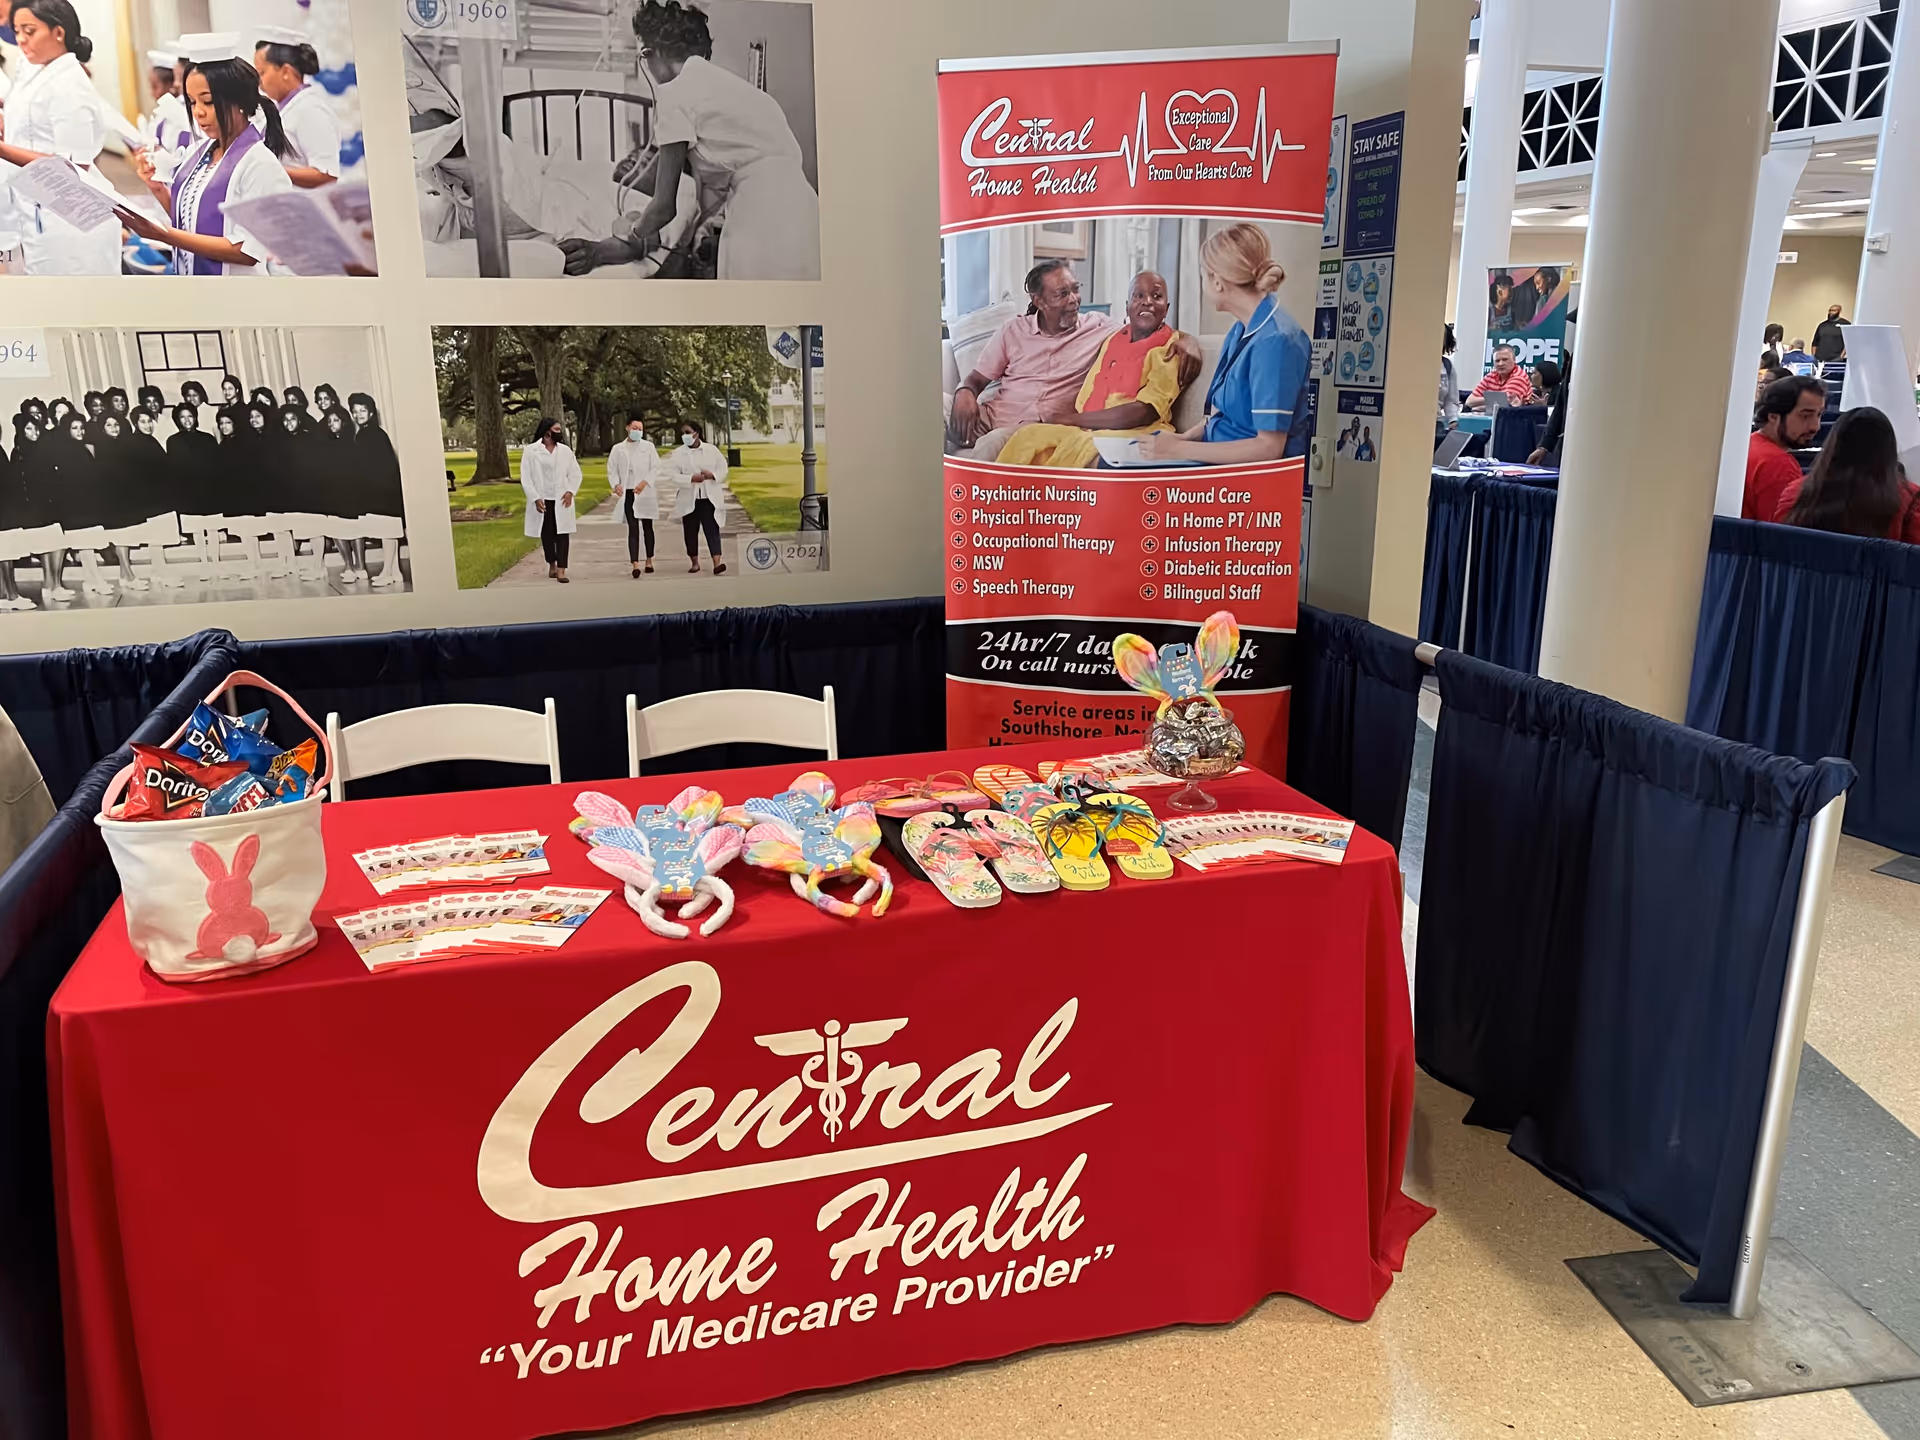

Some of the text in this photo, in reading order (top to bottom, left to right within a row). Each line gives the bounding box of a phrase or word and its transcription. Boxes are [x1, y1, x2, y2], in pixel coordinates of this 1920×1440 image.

[459, 0, 507, 23] 1960
[1171, 107, 1231, 126] Exceptional
[961, 97, 1098, 168] Central
[1188, 133, 1212, 152] Care
[1353, 131, 1399, 155] STAY SAFE
[967, 164, 1098, 198] Home Health
[1148, 160, 1253, 181] From Our Hearts Core
[971, 485, 1097, 506] Psychiatric Nursing
[1166, 487, 1252, 504] Wound Care
[972, 509, 1082, 530] Physical Therapy
[1165, 512, 1180, 528] In
[1182, 512, 1225, 529] Home
[1227, 511, 1244, 528] PT
[1255, 512, 1282, 528] INR
[787, 546, 823, 558] 2021
[972, 532, 1116, 555] Occupational Therapy
[1164, 536, 1282, 557] Infusion Therapy
[972, 556, 1005, 571] MSW
[1164, 560, 1293, 577] Diabetic Education
[972, 579, 1075, 599] Speech Therapy
[1163, 584, 1262, 604] Bilingual Staff
[977, 631, 1071, 654] 24hr/7
[981, 654, 1014, 671] On
[1018, 656, 1059, 672] call
[1013, 699, 1077, 718] Service
[1082, 704, 1136, 721] areas
[1001, 717, 1103, 739] Southshore
[477, 961, 1113, 1222] Central
[518, 1153, 1088, 1329] Home Health
[480, 1244, 1115, 1380] “Your Medicare Provider”
